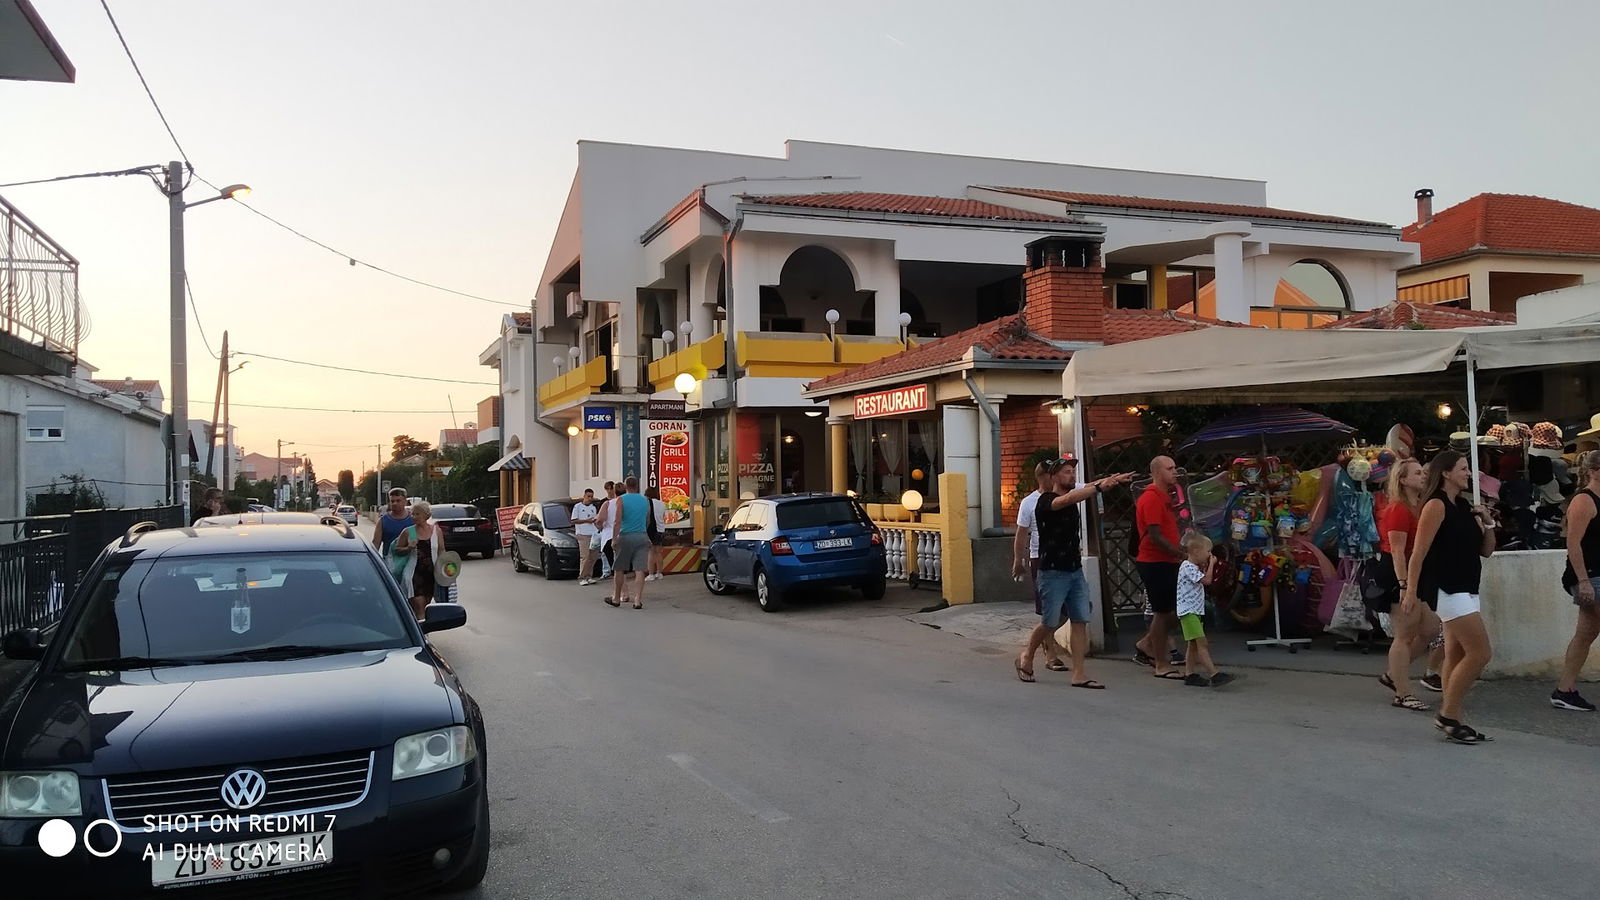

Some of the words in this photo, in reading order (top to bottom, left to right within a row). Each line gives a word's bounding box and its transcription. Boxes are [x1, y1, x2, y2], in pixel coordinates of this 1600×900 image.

[856, 388, 926, 416] RESTAURANT
[649, 403, 684, 411] APARTMANI
[587, 414, 606, 422] PSK
[648, 421, 684, 431] GORAN
[663, 448, 687, 457] GRILL
[665, 463, 684, 471] FISH
[738, 463, 774, 474] PIZZA
[663, 477, 688, 486] PIZZA
[175, 850, 207, 878] ZD
[235, 873, 260, 881] ARTON
